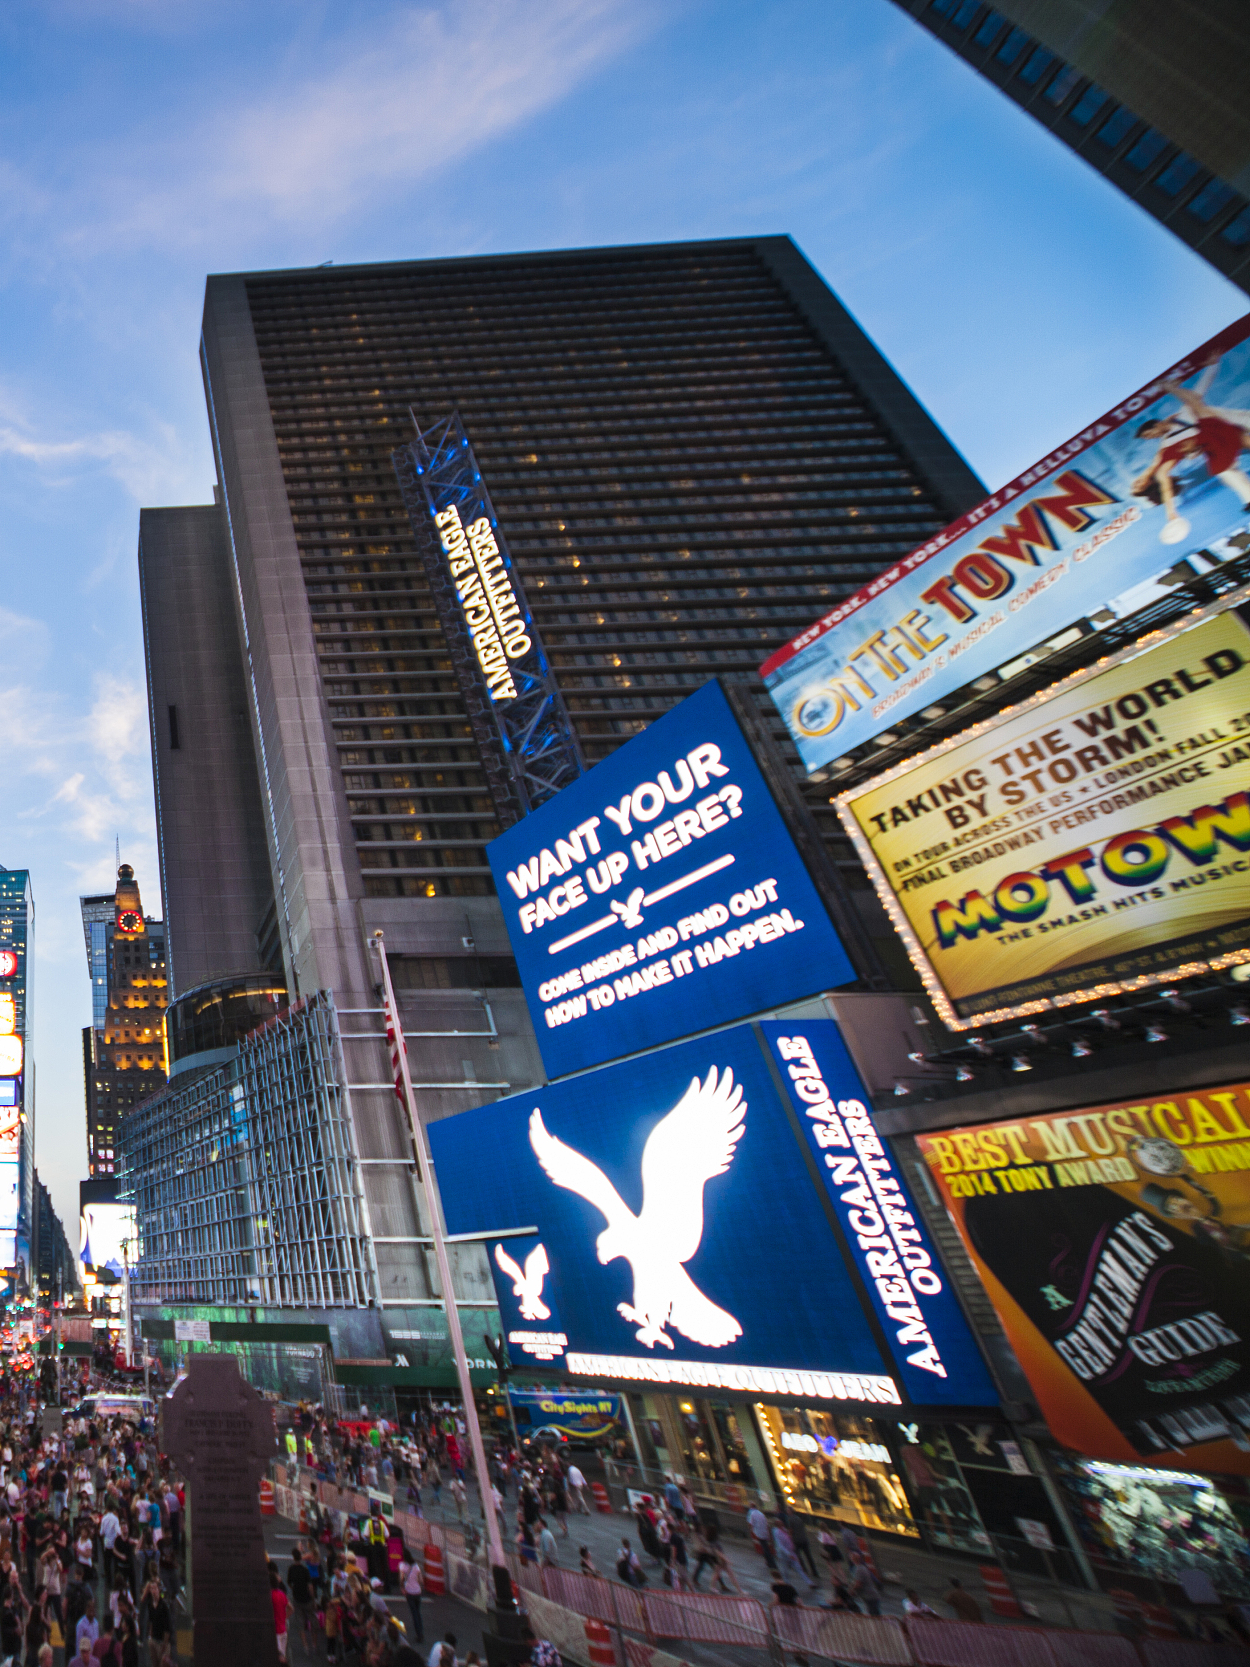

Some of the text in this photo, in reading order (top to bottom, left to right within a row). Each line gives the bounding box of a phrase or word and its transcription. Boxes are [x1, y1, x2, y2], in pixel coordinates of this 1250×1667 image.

[435, 504, 517, 701] AMERICAN EAGLE
[465, 516, 532, 659] OUTFITTERS
[792, 626, 821, 650] NEW
[867, 568, 901, 596] NEW
[966, 498, 1001, 524] IT'S
[1004, 488, 1020, 501] A
[1020, 423, 1113, 487] HELLUVA
[792, 469, 1123, 737] ON THE TOWN
[872, 655, 946, 719] BROADWAY'S
[1008, 558, 1070, 613] COMEDY
[1073, 506, 1143, 562] CLASSIC
[870, 648, 1245, 833] TAKING THE WORLD
[893, 728, 1229, 873] ON TOUR ACROSS THE US LONDON FALL
[944, 718, 1168, 830] BY STORM!
[506, 742, 730, 899] WANT YOUR
[518, 784, 743, 934] FACE UP HERE?
[900, 762, 1214, 892] FINAL BROADWAY PERFORMANCE
[538, 878, 779, 1002] COME INSIDE AND FIND OUT
[544, 908, 805, 1028] HOW TO MAKE IT HAPPEN.
[997, 886, 1167, 945] THE SMASH HITS
[776, 1035, 948, 1378] AMERICAN EAGLE
[837, 1098, 942, 1296] OUTFITTERS
[926, 1125, 1034, 1174] BEST
[945, 1157, 1139, 1198] 2014 TONY AWARD
[1039, 1284, 1074, 1311] A
[1053, 1210, 1175, 1381] GENTLEMAN'S
[1127, 1310, 1242, 1367] GUIDE
[540, 1400, 598, 1415] CitySights
[565, 1352, 661, 1382] AMERICAN
[661, 1358, 728, 1388] EAGLE
